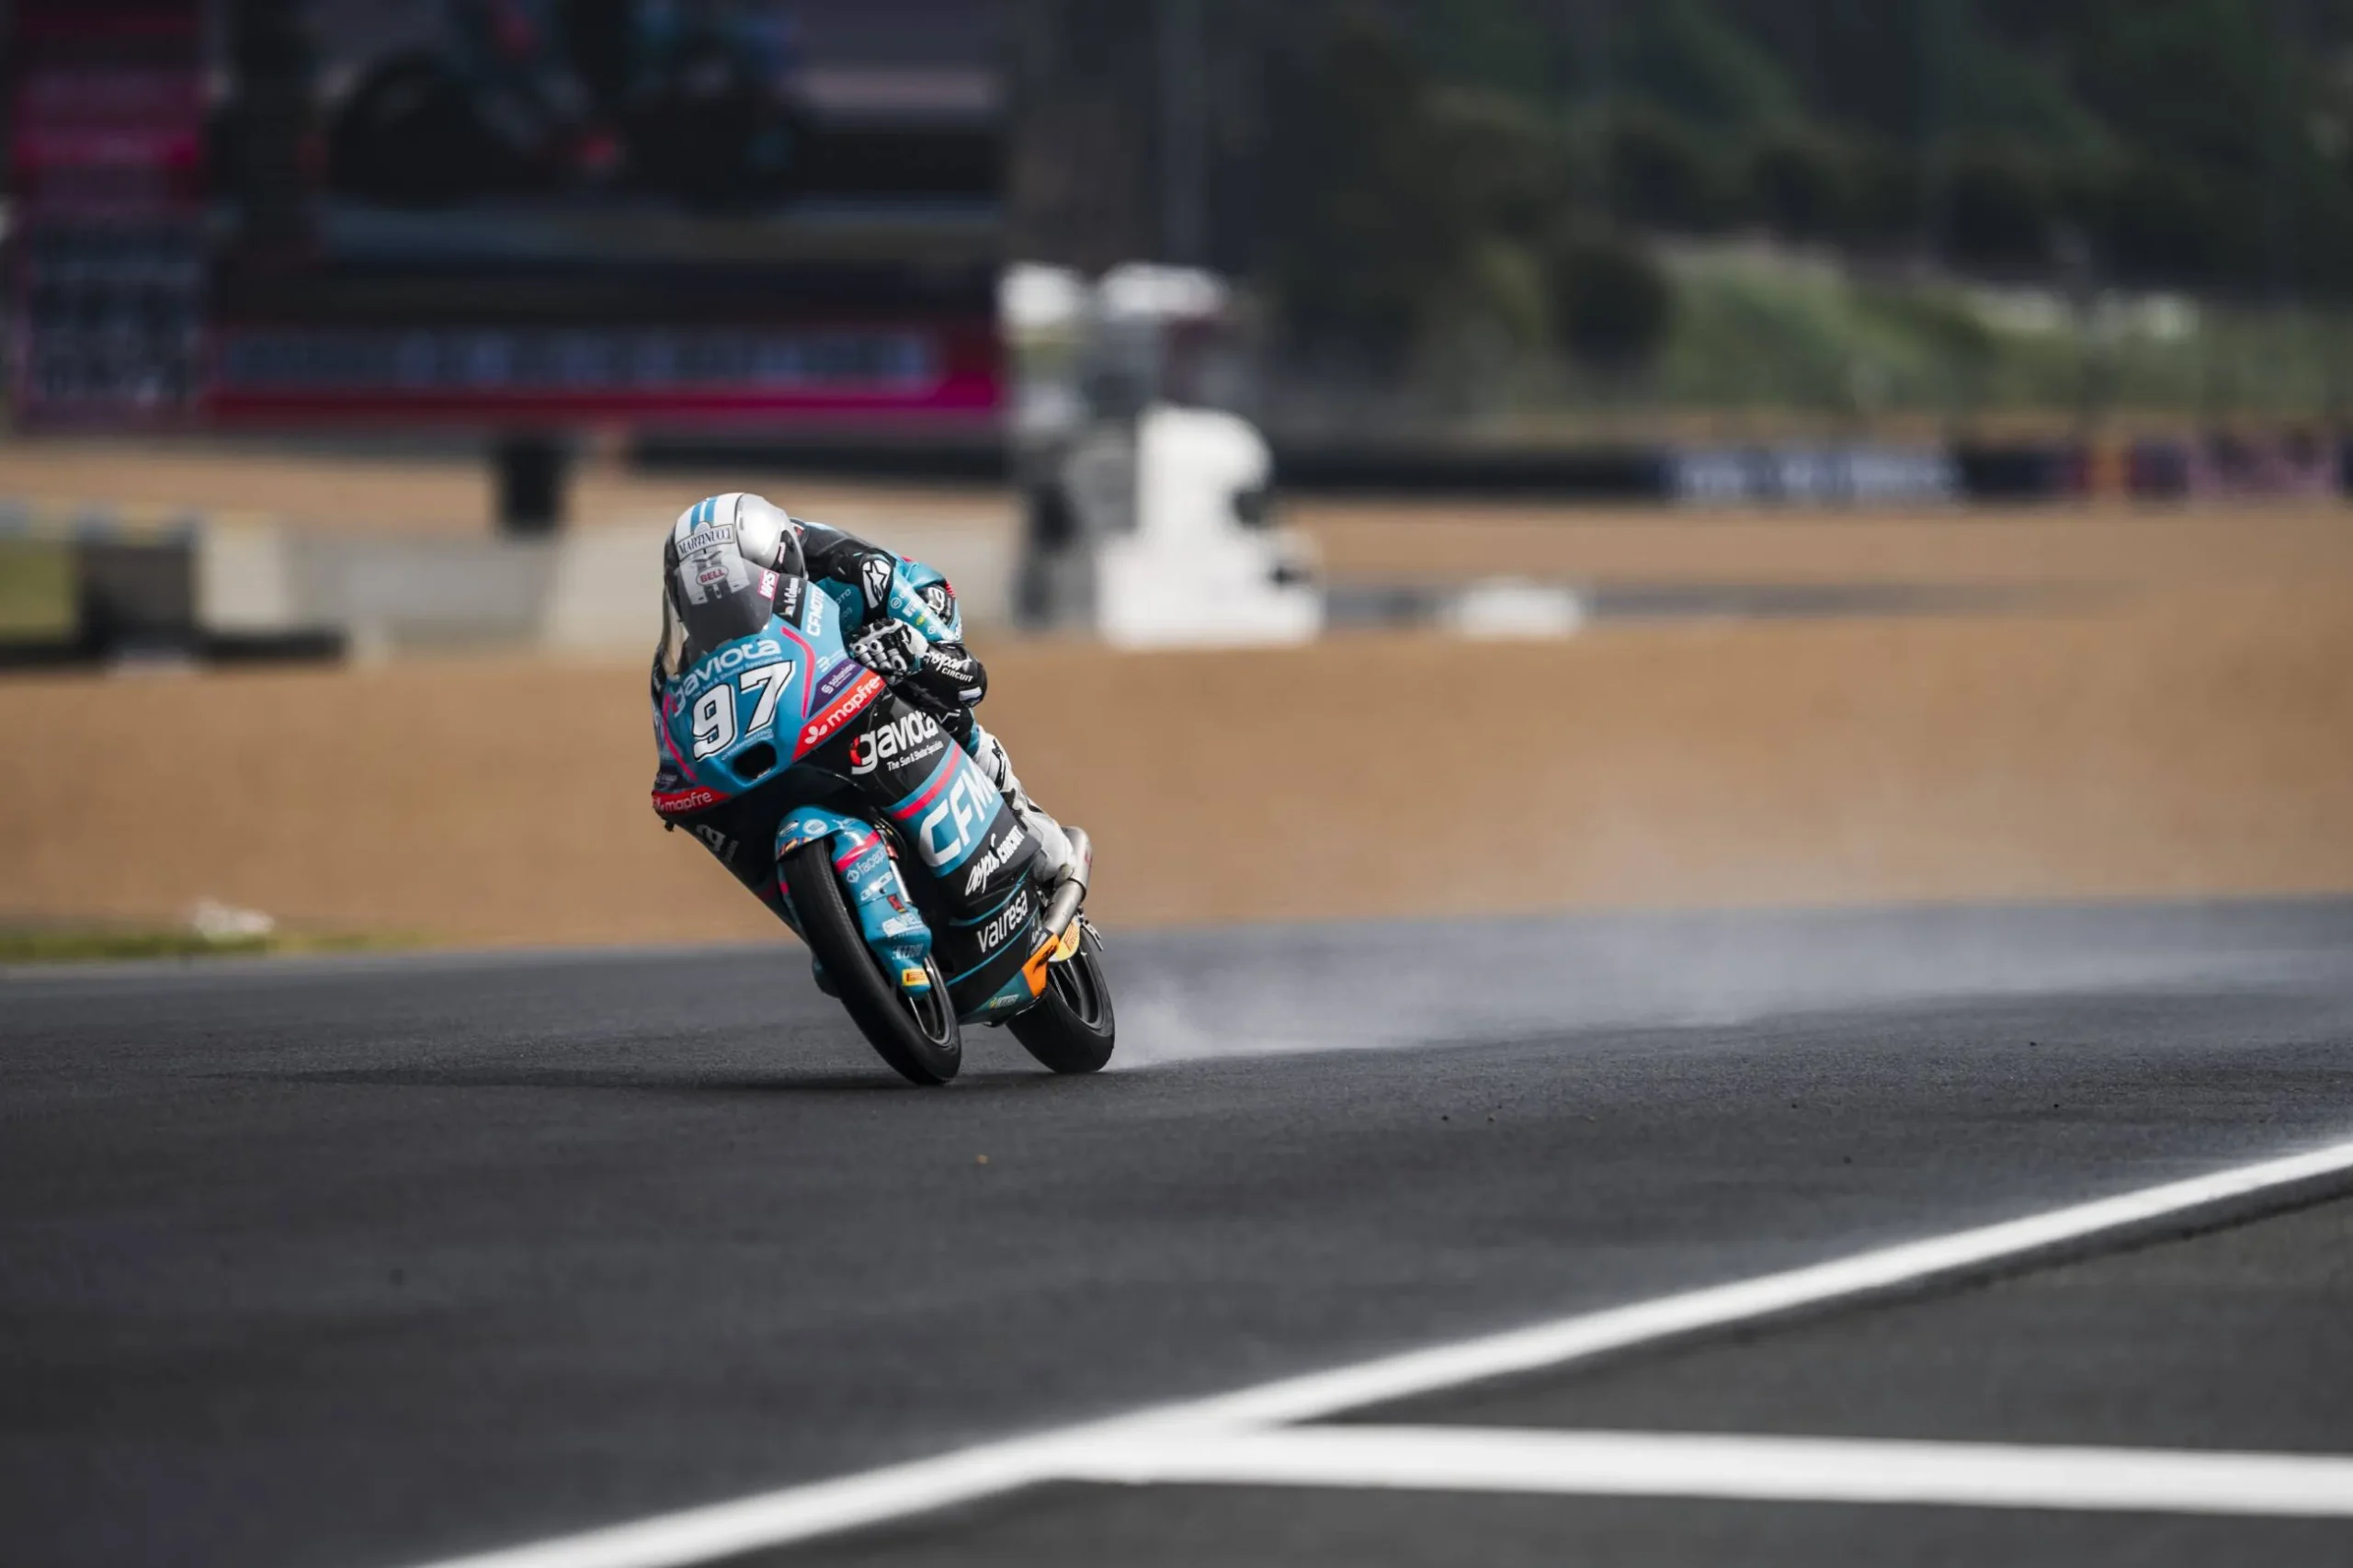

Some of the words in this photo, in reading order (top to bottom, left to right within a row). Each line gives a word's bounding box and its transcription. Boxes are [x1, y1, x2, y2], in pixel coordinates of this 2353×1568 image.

[699, 569, 724, 584] BELL
[941, 668, 973, 682] CIRCUIT
[693, 660, 796, 763] 97
[827, 676, 881, 727] mapfre
[849, 710, 938, 775] gaviota
[665, 791, 713, 812] mapfre
